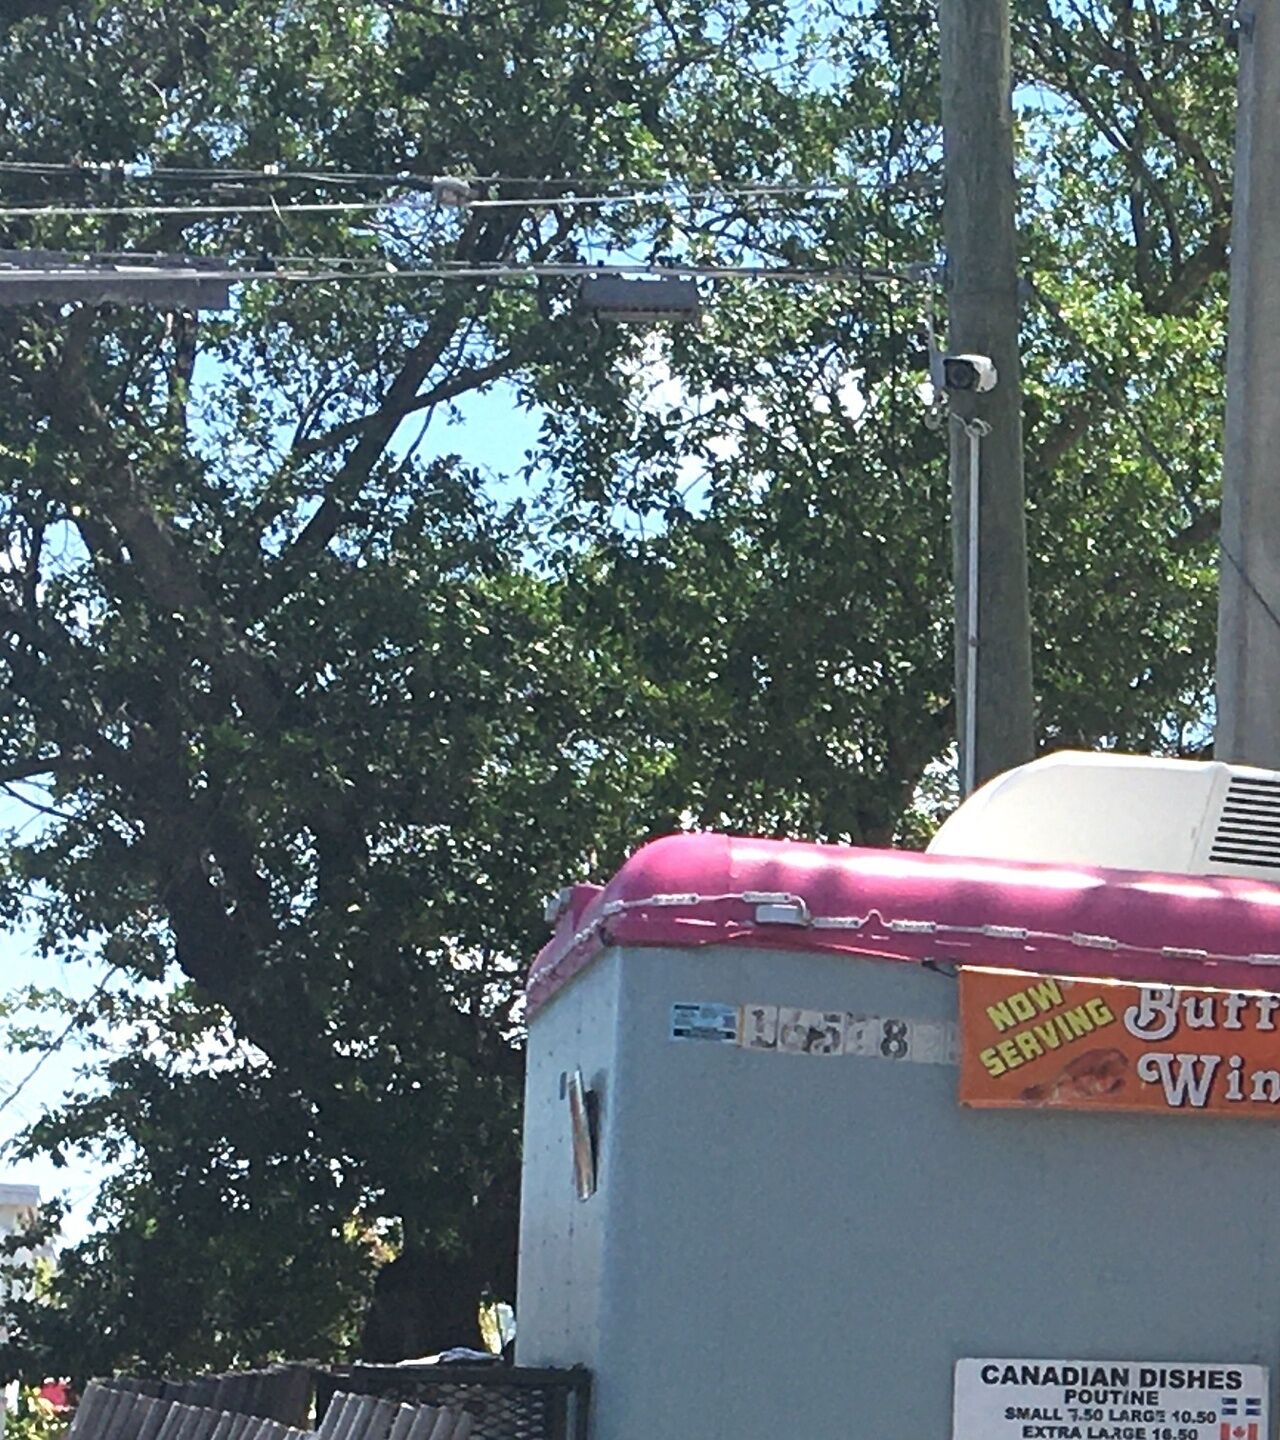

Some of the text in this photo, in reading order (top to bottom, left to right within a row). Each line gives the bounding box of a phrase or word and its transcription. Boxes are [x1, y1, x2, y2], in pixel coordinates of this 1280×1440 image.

[986, 979, 1065, 1033] NOW
[979, 998, 1115, 1078] SERVING
[981, 1364, 1242, 1390] CANADIAN DISHES
[1064, 1389, 1159, 1406] POUTINE
[1004, 1406, 1217, 1424] SMALL 7.50 LARGE 10.50
[1022, 1425, 1082, 1439] EXTRA
[1087, 1427, 1147, 1440] LARGE
